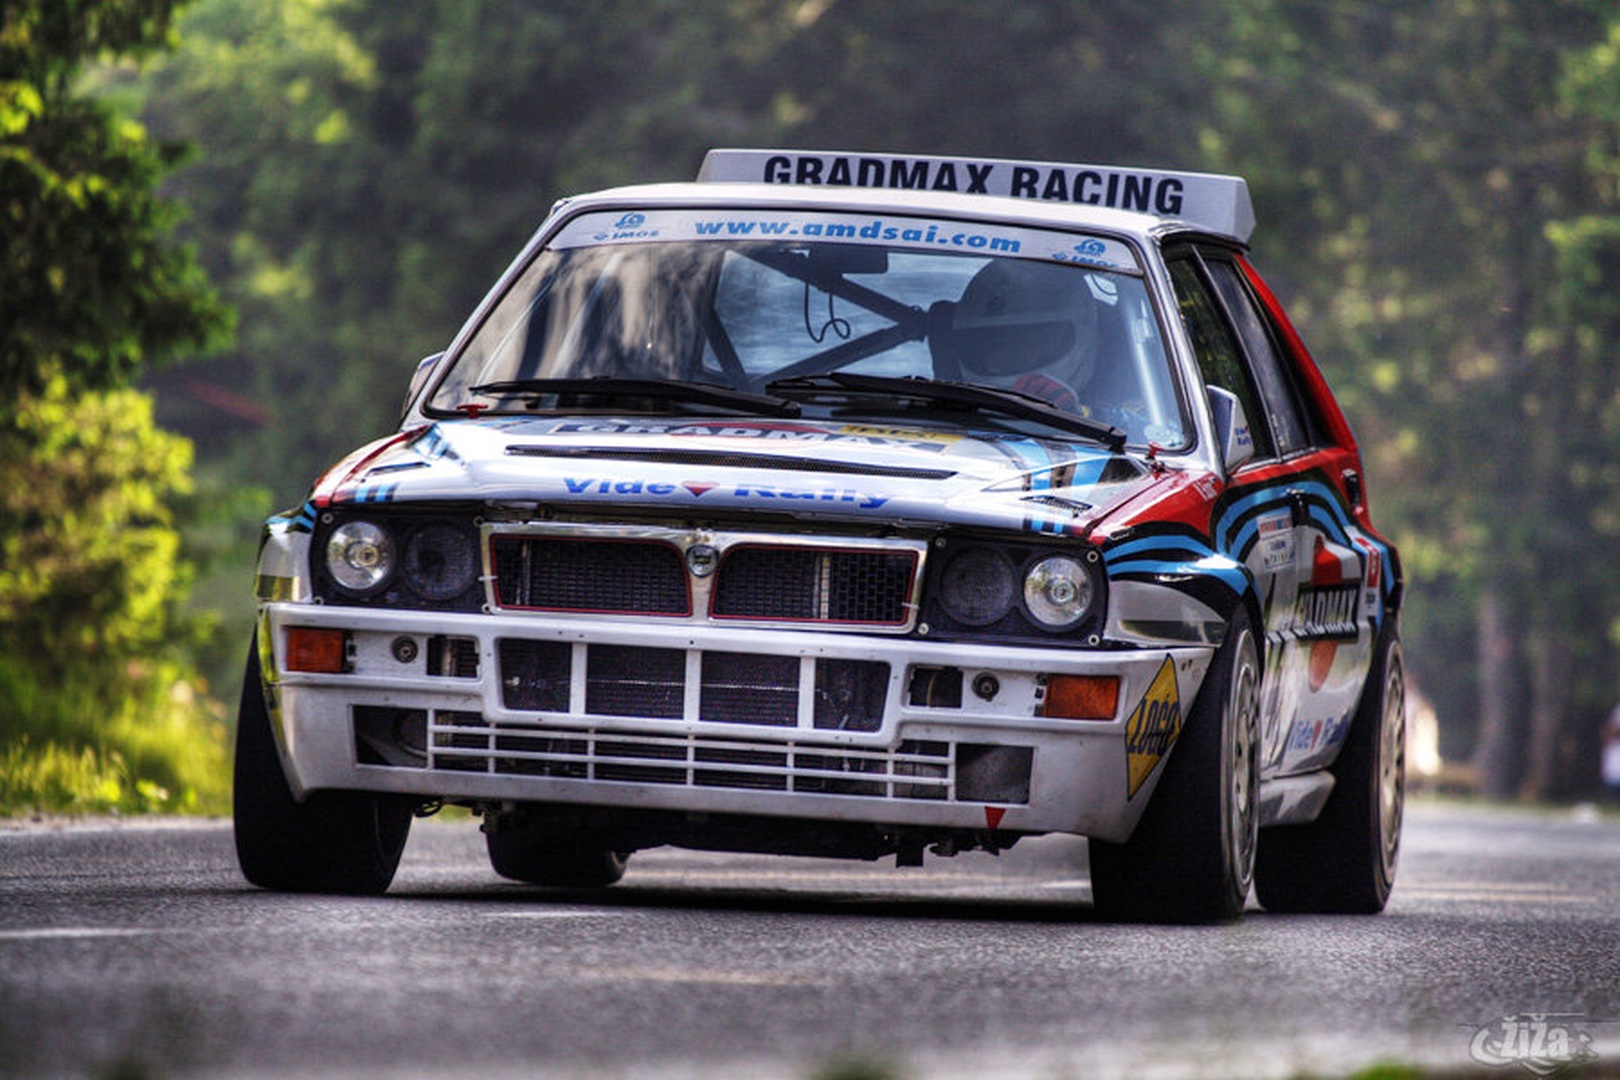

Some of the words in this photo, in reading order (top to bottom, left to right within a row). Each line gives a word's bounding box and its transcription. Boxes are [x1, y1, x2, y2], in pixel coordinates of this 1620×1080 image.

[764, 156, 993, 195] GRADMAX
[1011, 166, 1185, 215] RACING
[695, 219, 1021, 254] www.amdsai.com
